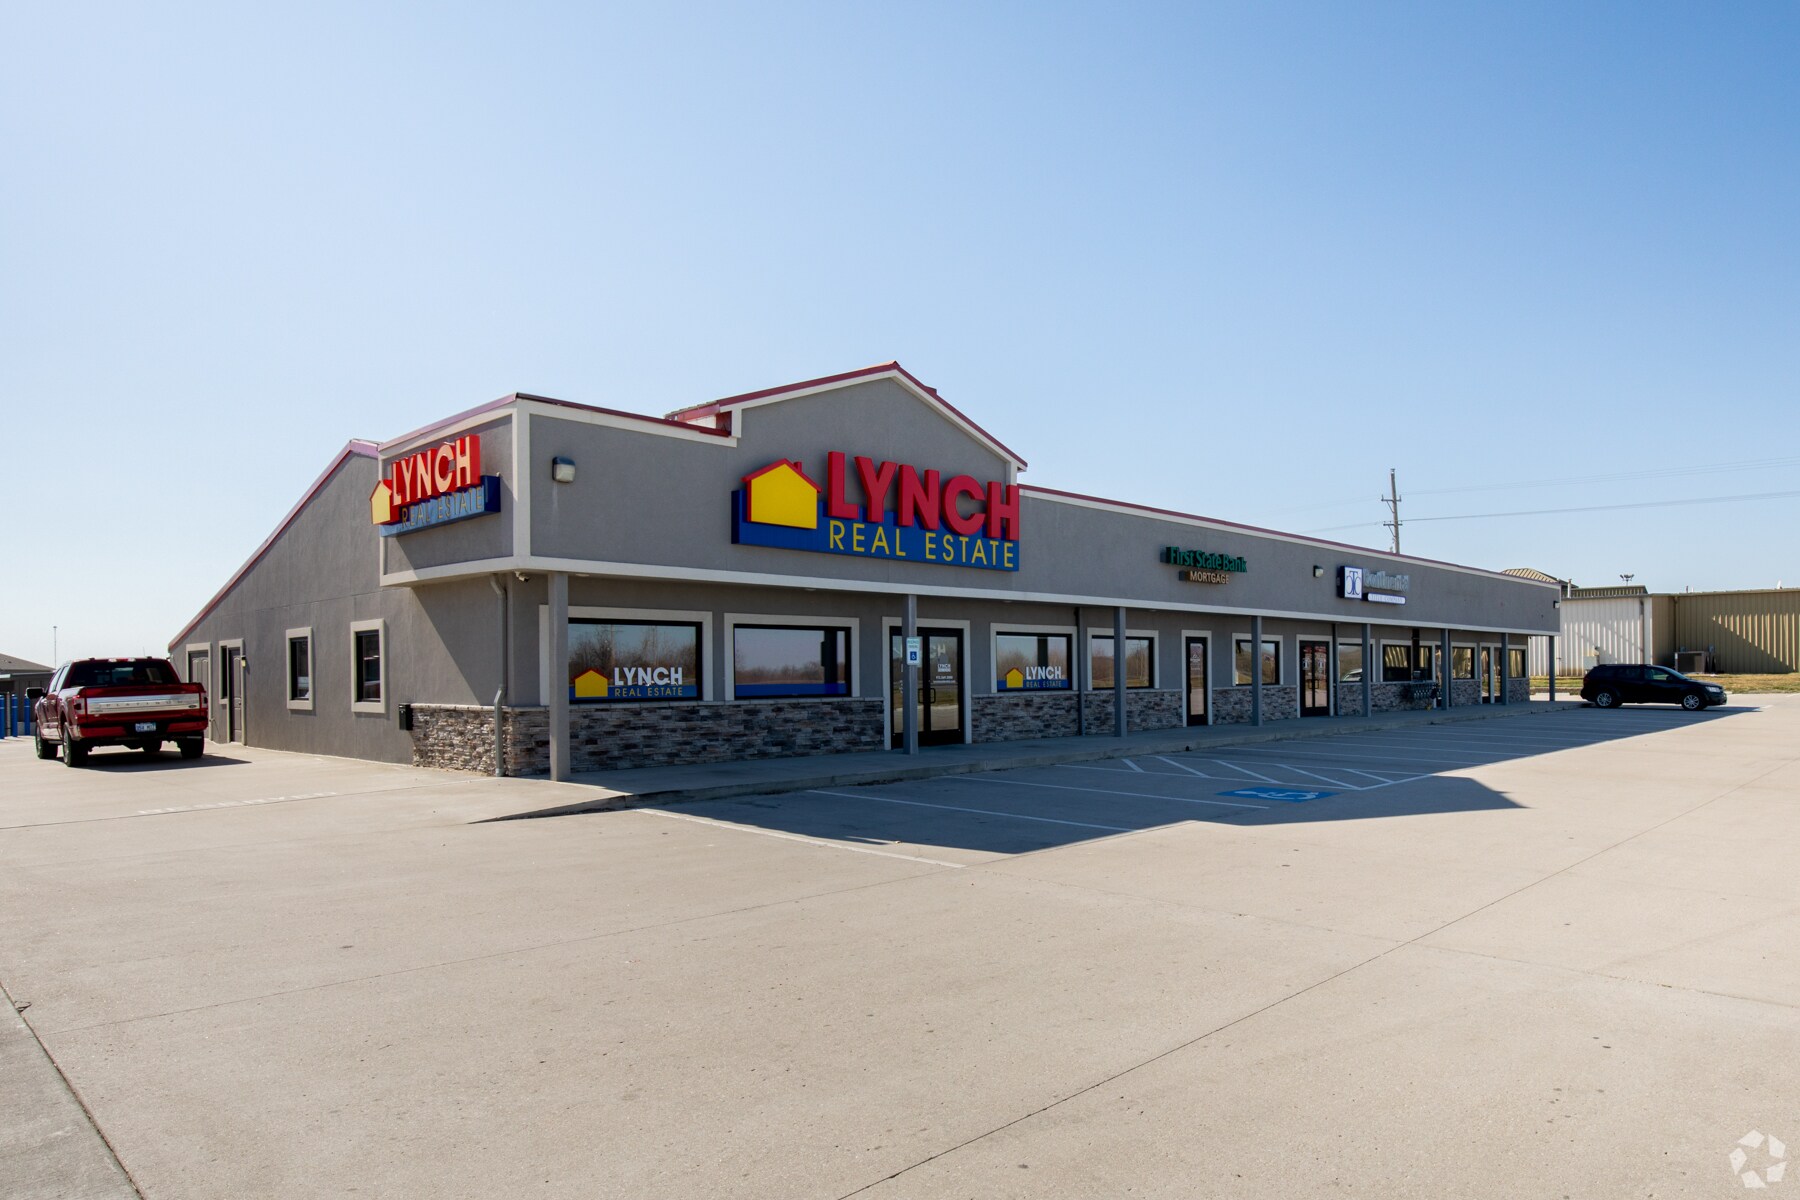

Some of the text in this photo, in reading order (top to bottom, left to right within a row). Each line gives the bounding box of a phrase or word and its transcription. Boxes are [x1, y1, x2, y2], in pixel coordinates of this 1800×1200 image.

[392, 434, 480, 506] LYNCH
[828, 451, 1019, 541] LYNCH
[402, 487, 483, 529] REAL ESTATE
[829, 520, 1014, 568] REAL ESTATE
[1169, 546, 1248, 573] First State Bank
[1190, 570, 1230, 584] MORTGAGE
[614, 666, 683, 686] LYNCH
[1025, 666, 1062, 680] LYNCH
[1042, 680, 1062, 688] ESTATE
[614, 687, 683, 697] REAL ESTATE
